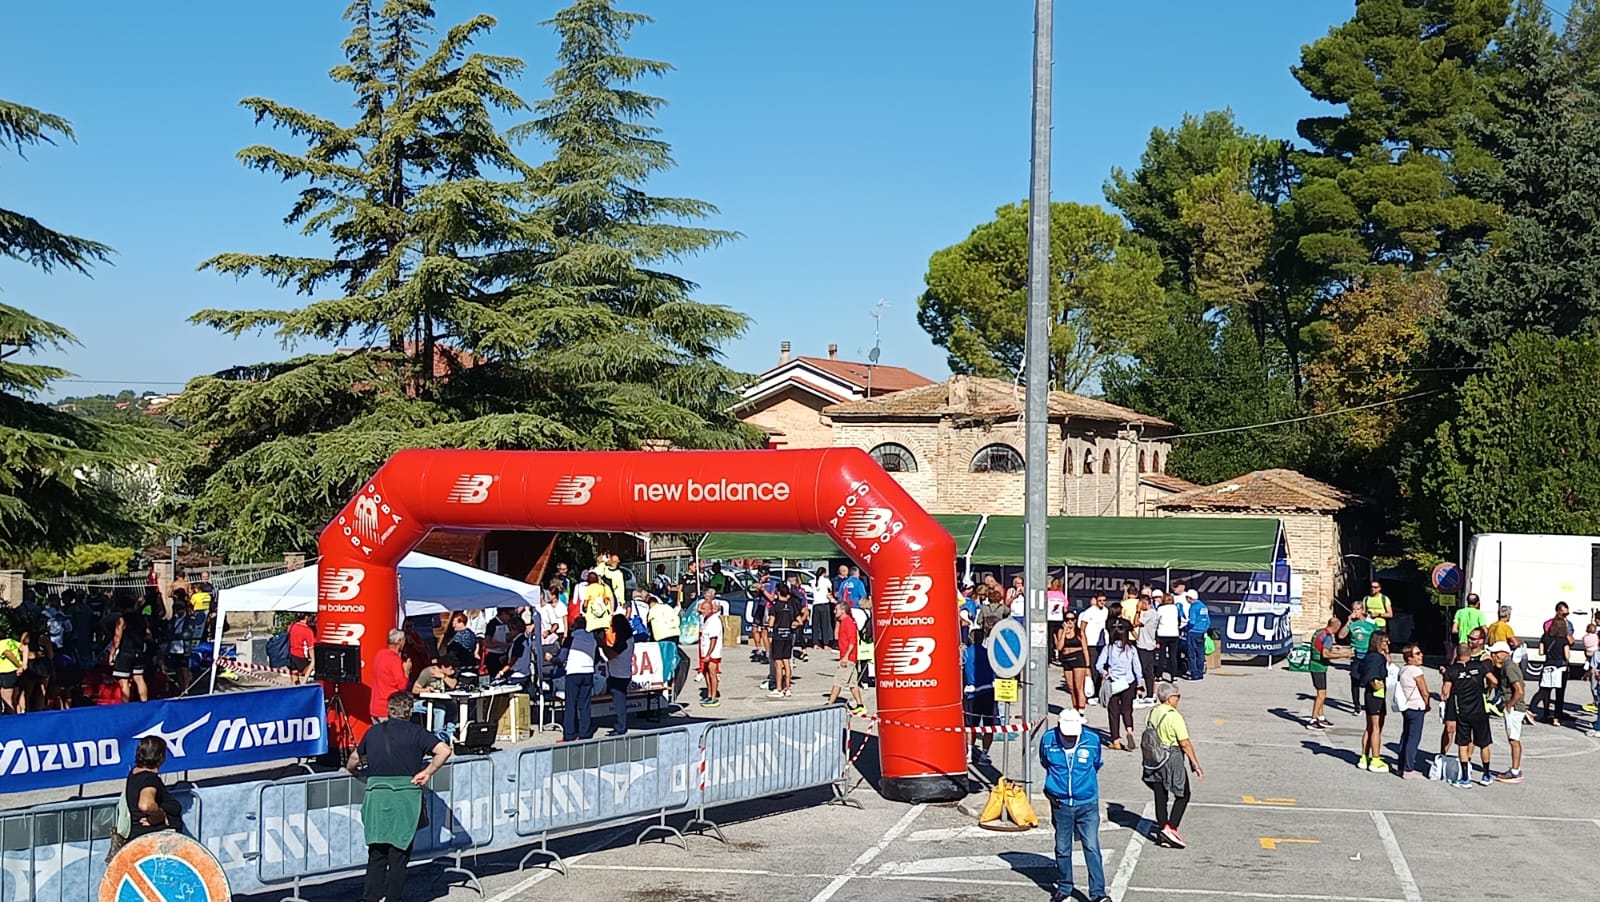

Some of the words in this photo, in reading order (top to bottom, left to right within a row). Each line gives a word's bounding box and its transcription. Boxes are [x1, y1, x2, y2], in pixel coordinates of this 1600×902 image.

[633, 483, 684, 502] new
[687, 478, 790, 502] balance
[327, 603, 366, 612] balance
[893, 615, 934, 626] balance
[880, 680, 895, 689] new
[895, 677, 937, 688] balance
[206, 716, 321, 754] MIZUNO
